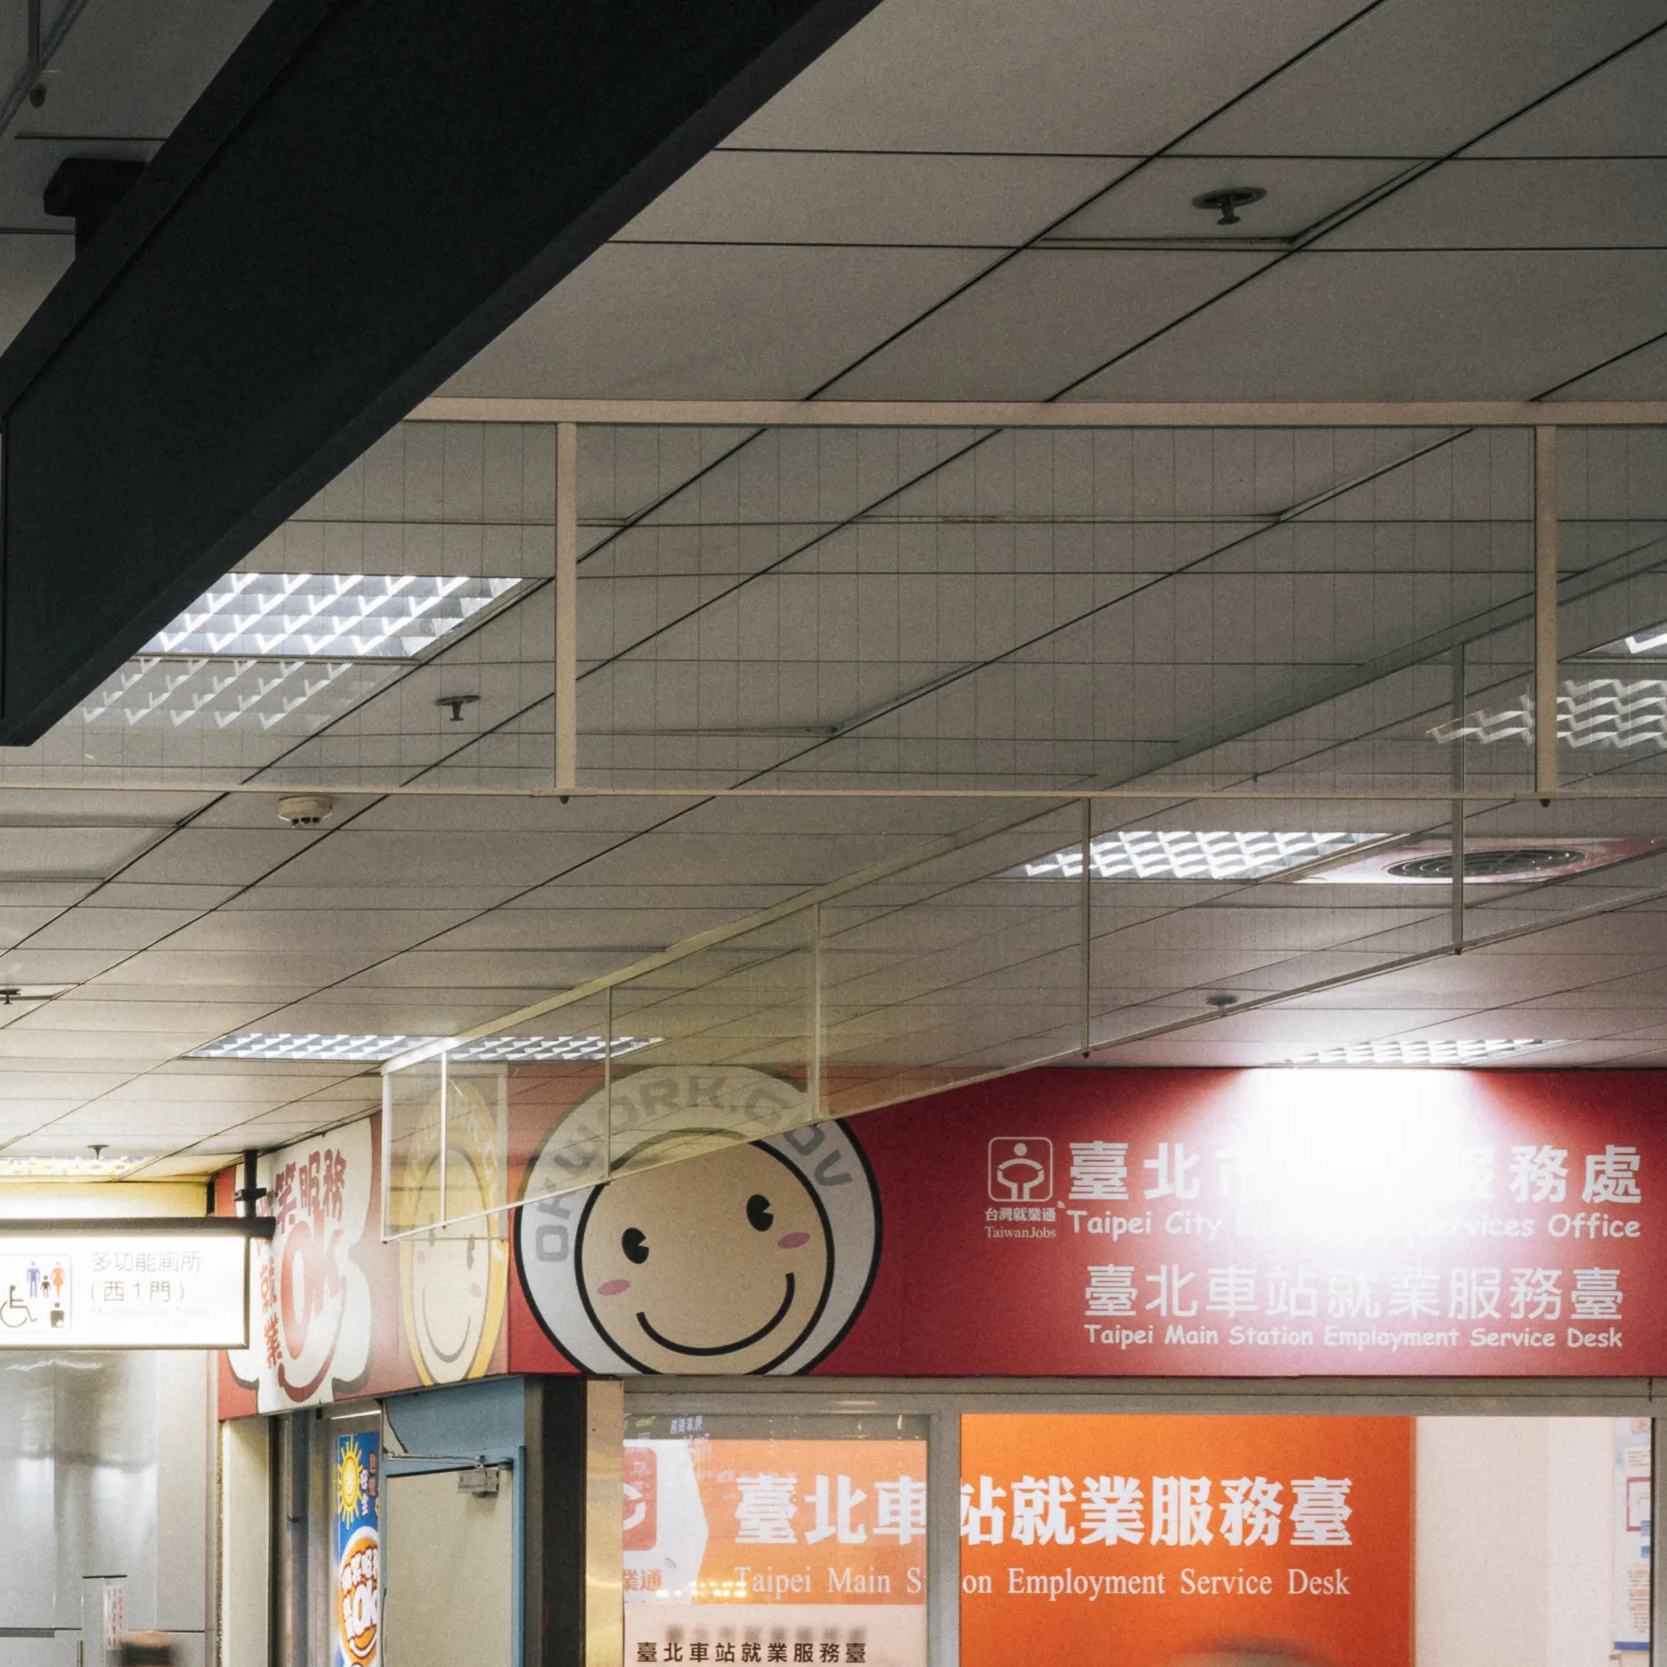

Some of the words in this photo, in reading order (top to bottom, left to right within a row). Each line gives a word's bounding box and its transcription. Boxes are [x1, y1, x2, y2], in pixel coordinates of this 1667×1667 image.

[984, 1207, 1057, 1223] 台灣就業通
[1066, 1209, 1152, 1241] Taipei
[1165, 1209, 1221, 1241] City
[1547, 1212, 1642, 1240] Office
[984, 1225, 1057, 1239] TaiwanJobs
[1083, 1263, 1624, 1320] 臺北車站就業服務臺
[1083, 1324, 1155, 1350] Taipei
[1164, 1325, 1219, 1345] Main
[1228, 1325, 1314, 1346] Station
[1323, 1325, 1460, 1353] Employment
[1469, 1326, 1556, 1348] Service
[1567, 1327, 1624, 1349] Desk
[733, 1565, 812, 1600] Taipei
[826, 1566, 891, 1594] Main
[1007, 1567, 1166, 1601] Employment
[1180, 1567, 1273, 1596] Service
[1287, 1568, 1351, 1596] Desk
[636, 1641, 867, 1664] 臺北車站就業服務臺
